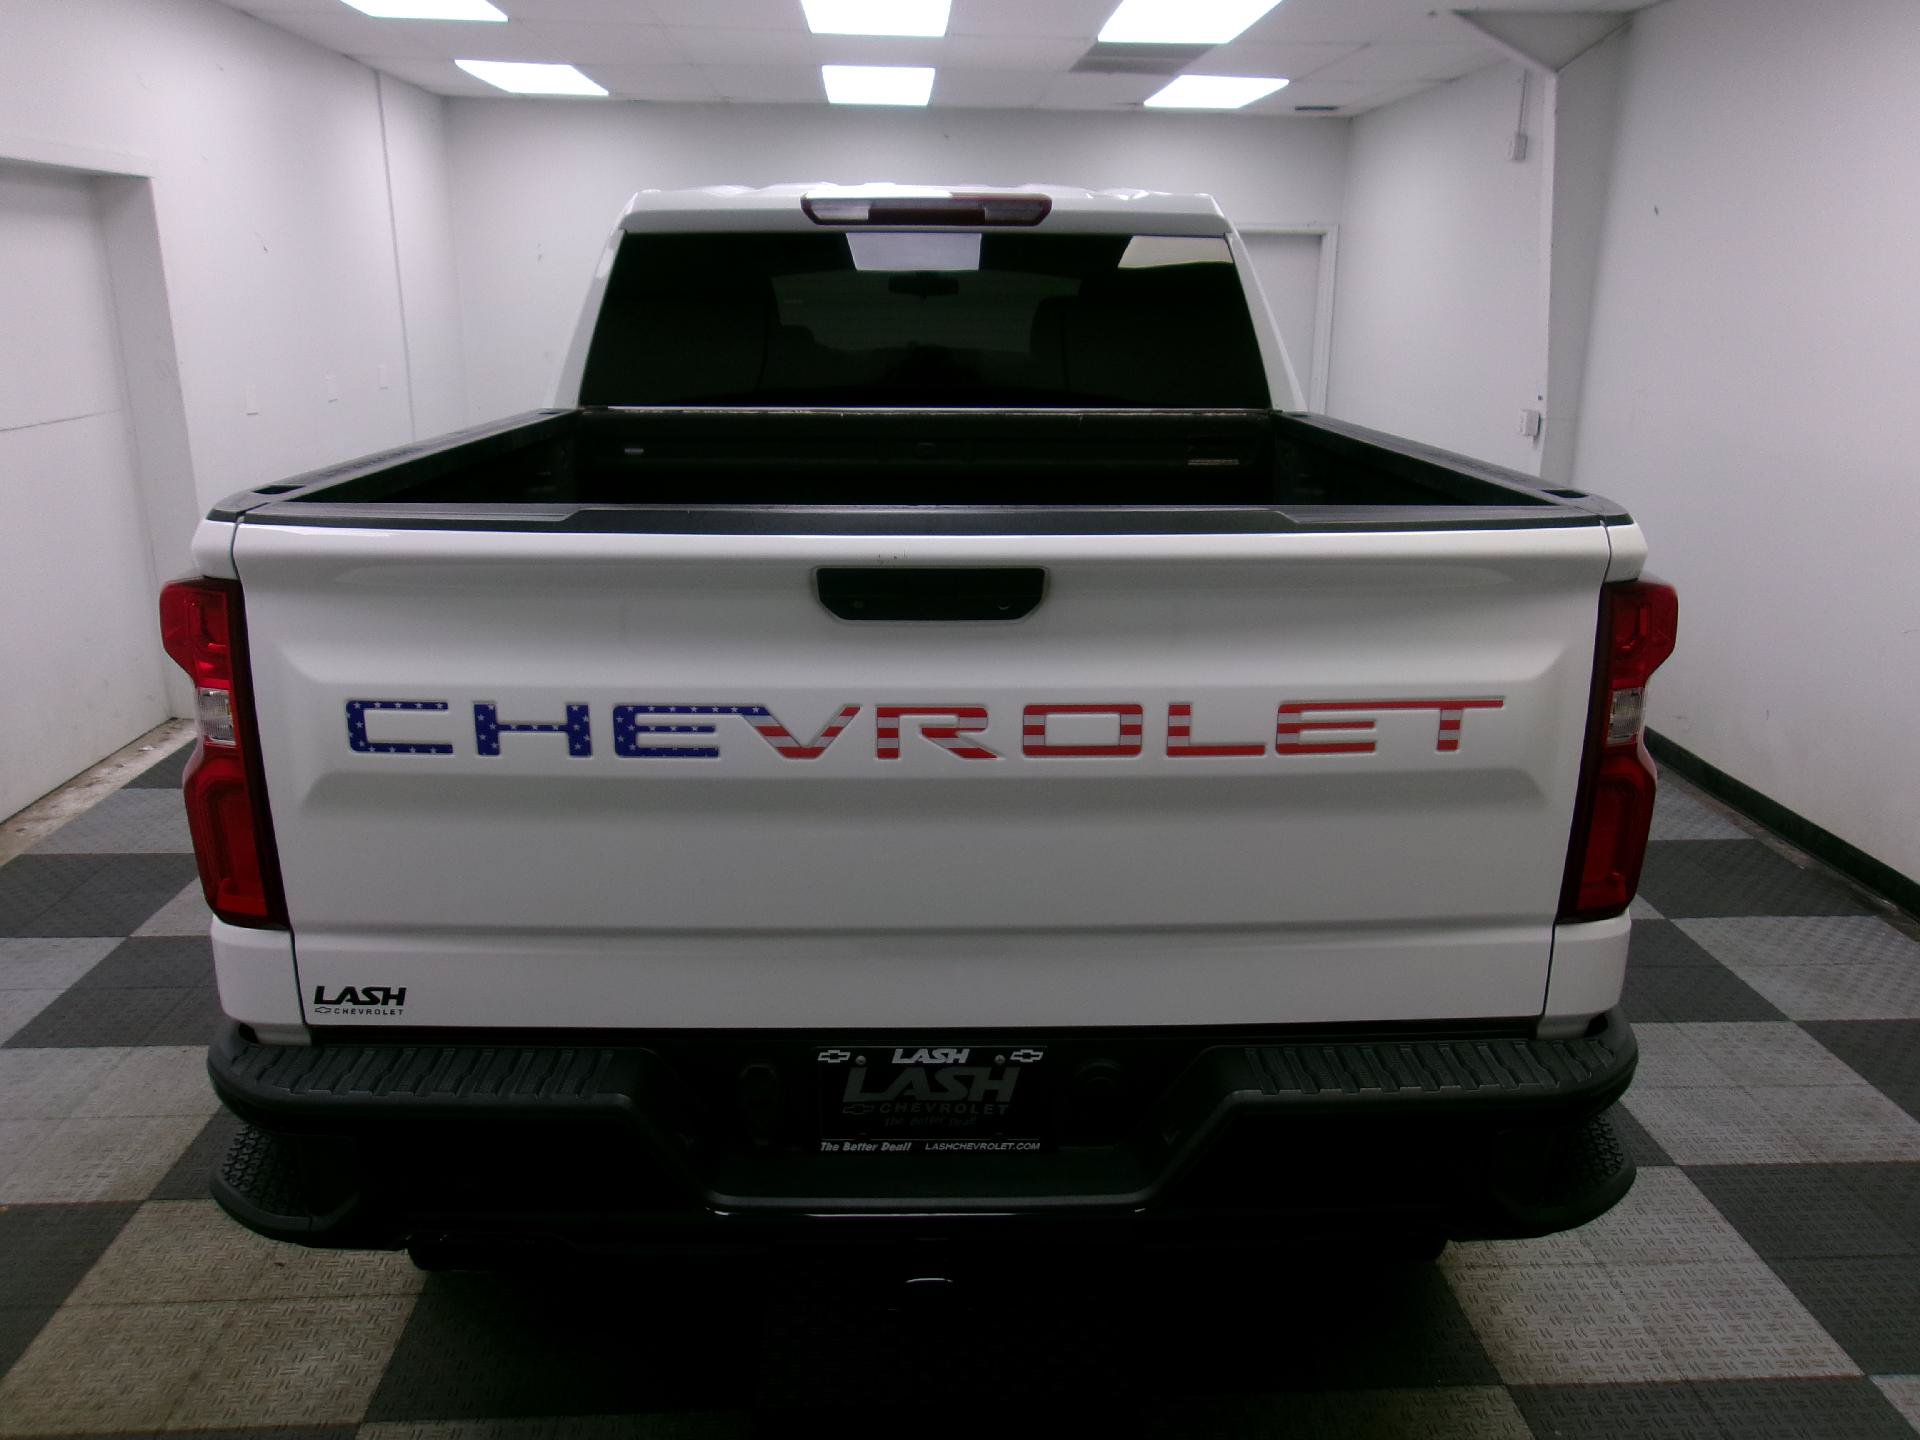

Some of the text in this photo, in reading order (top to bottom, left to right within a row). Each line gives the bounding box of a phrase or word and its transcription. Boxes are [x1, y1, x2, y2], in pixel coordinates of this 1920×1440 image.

[345, 699, 1504, 760] CHEVROLET
[314, 986, 407, 1006] LASH
[892, 1048, 970, 1064] LASH
[843, 1066, 1021, 1102] LASH
[879, 1102, 1009, 1115] CHEVROLET
[820, 1142, 839, 1152] The
[842, 1142, 878, 1152] Better
[924, 1142, 1041, 1151] LASHCHEVROLET.COM
